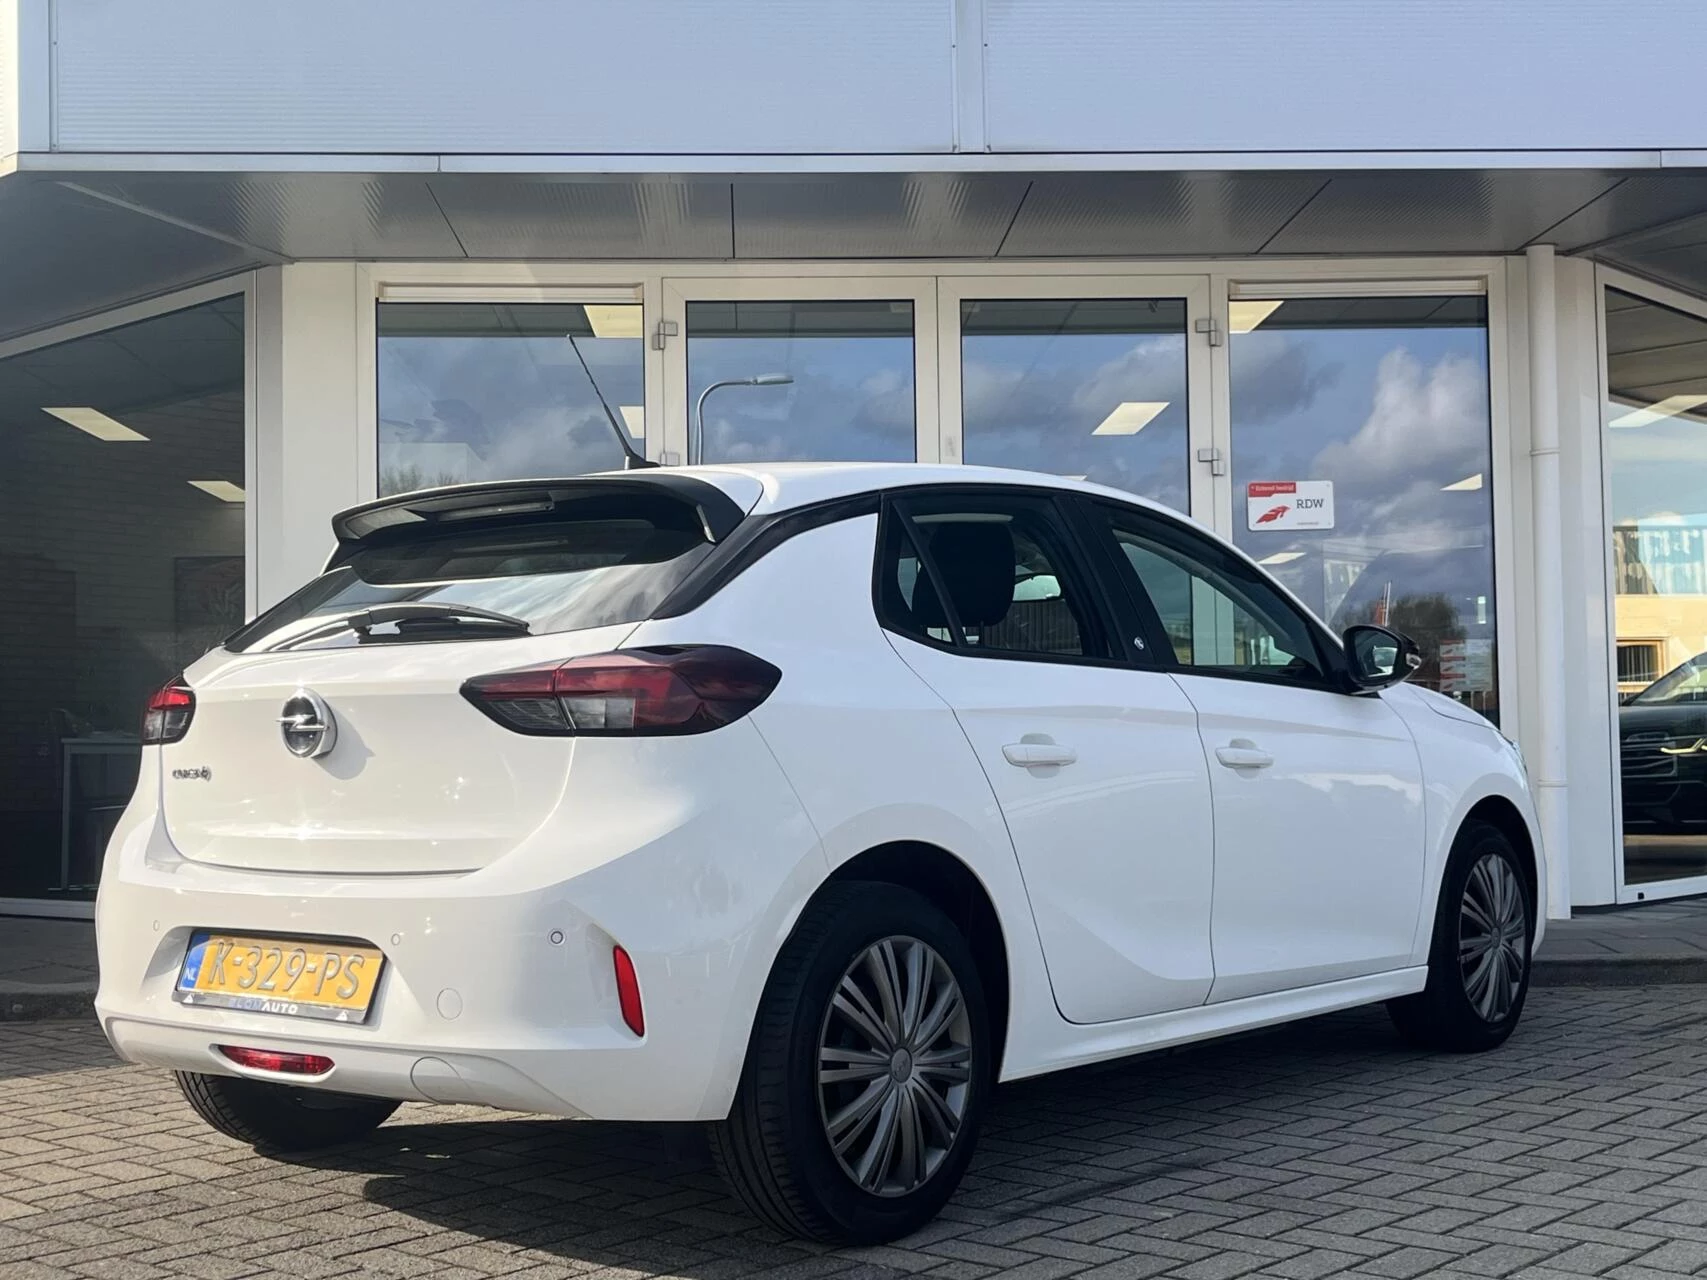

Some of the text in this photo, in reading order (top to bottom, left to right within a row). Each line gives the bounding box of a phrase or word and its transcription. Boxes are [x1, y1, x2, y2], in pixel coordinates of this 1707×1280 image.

[1296, 498, 1324, 509] RDW
[184, 967, 196, 981] NL
[208, 942, 365, 999] K-329-PS
